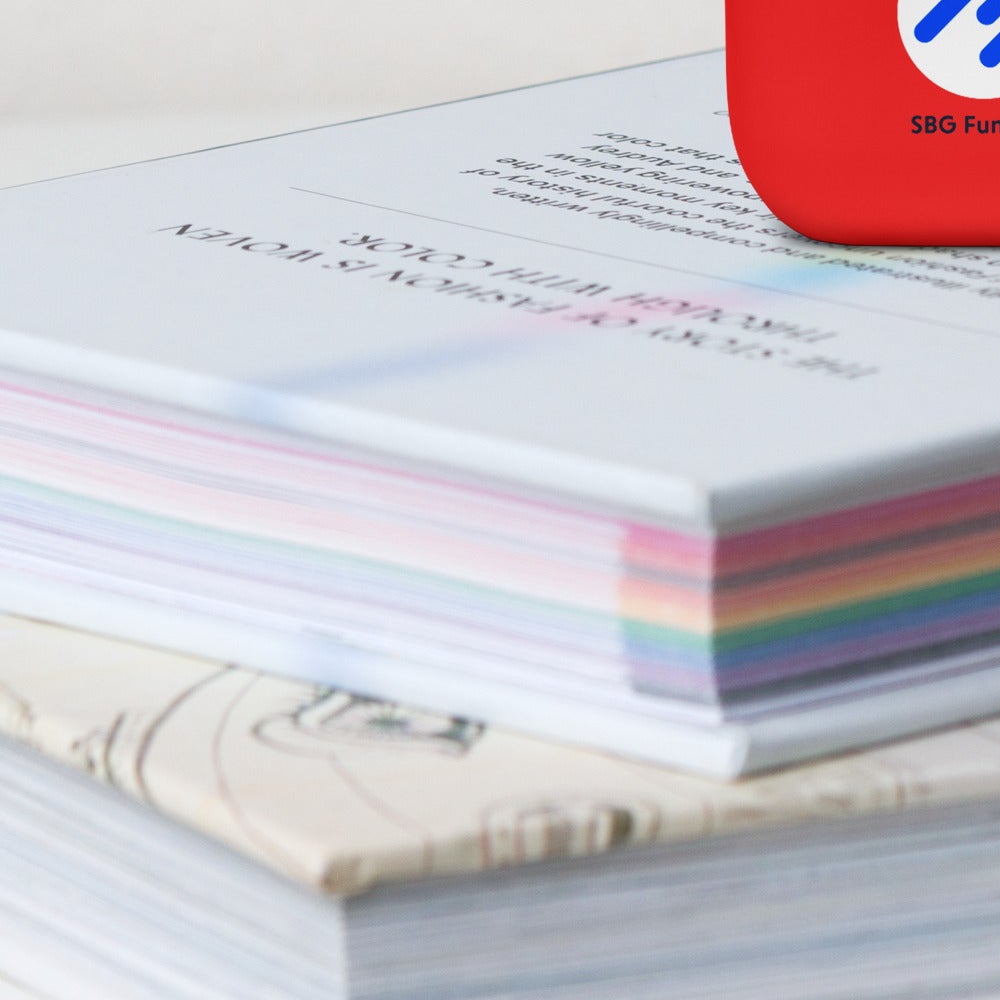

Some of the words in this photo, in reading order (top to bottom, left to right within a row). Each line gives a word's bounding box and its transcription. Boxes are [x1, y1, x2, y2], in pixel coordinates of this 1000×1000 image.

[911, 115, 957, 135] SBG
[592, 131, 668, 149] color
[495, 157, 544, 172] the
[544, 152, 644, 174] yellow
[580, 144, 685, 168] Audrey
[664, 146, 725, 162] that
[458, 168, 500, 177] of
[544, 168, 575, 178] in
[677, 165, 740, 180] and
[498, 175, 598, 199] history
[574, 174, 705, 204] moments
[634, 170, 760, 201] powering
[491, 187, 589, 213] written,
[590, 195, 704, 220] colorful
[701, 201, 758, 215] key
[588, 210, 766, 249] compellingly
[705, 218, 754, 231] the
[152, 223, 324, 263] WOVEN
[339, 232, 495, 270] COLOR.
[760, 246, 826, 261] and
[321, 259, 378, 273] IS
[370, 269, 571, 315] FASHION
[490, 267, 612, 297] WITH
[562, 312, 639, 330] OF
[610, 292, 838, 344] THROUGH
[636, 326, 791, 360] STORY
[786, 356, 880, 382] THE
